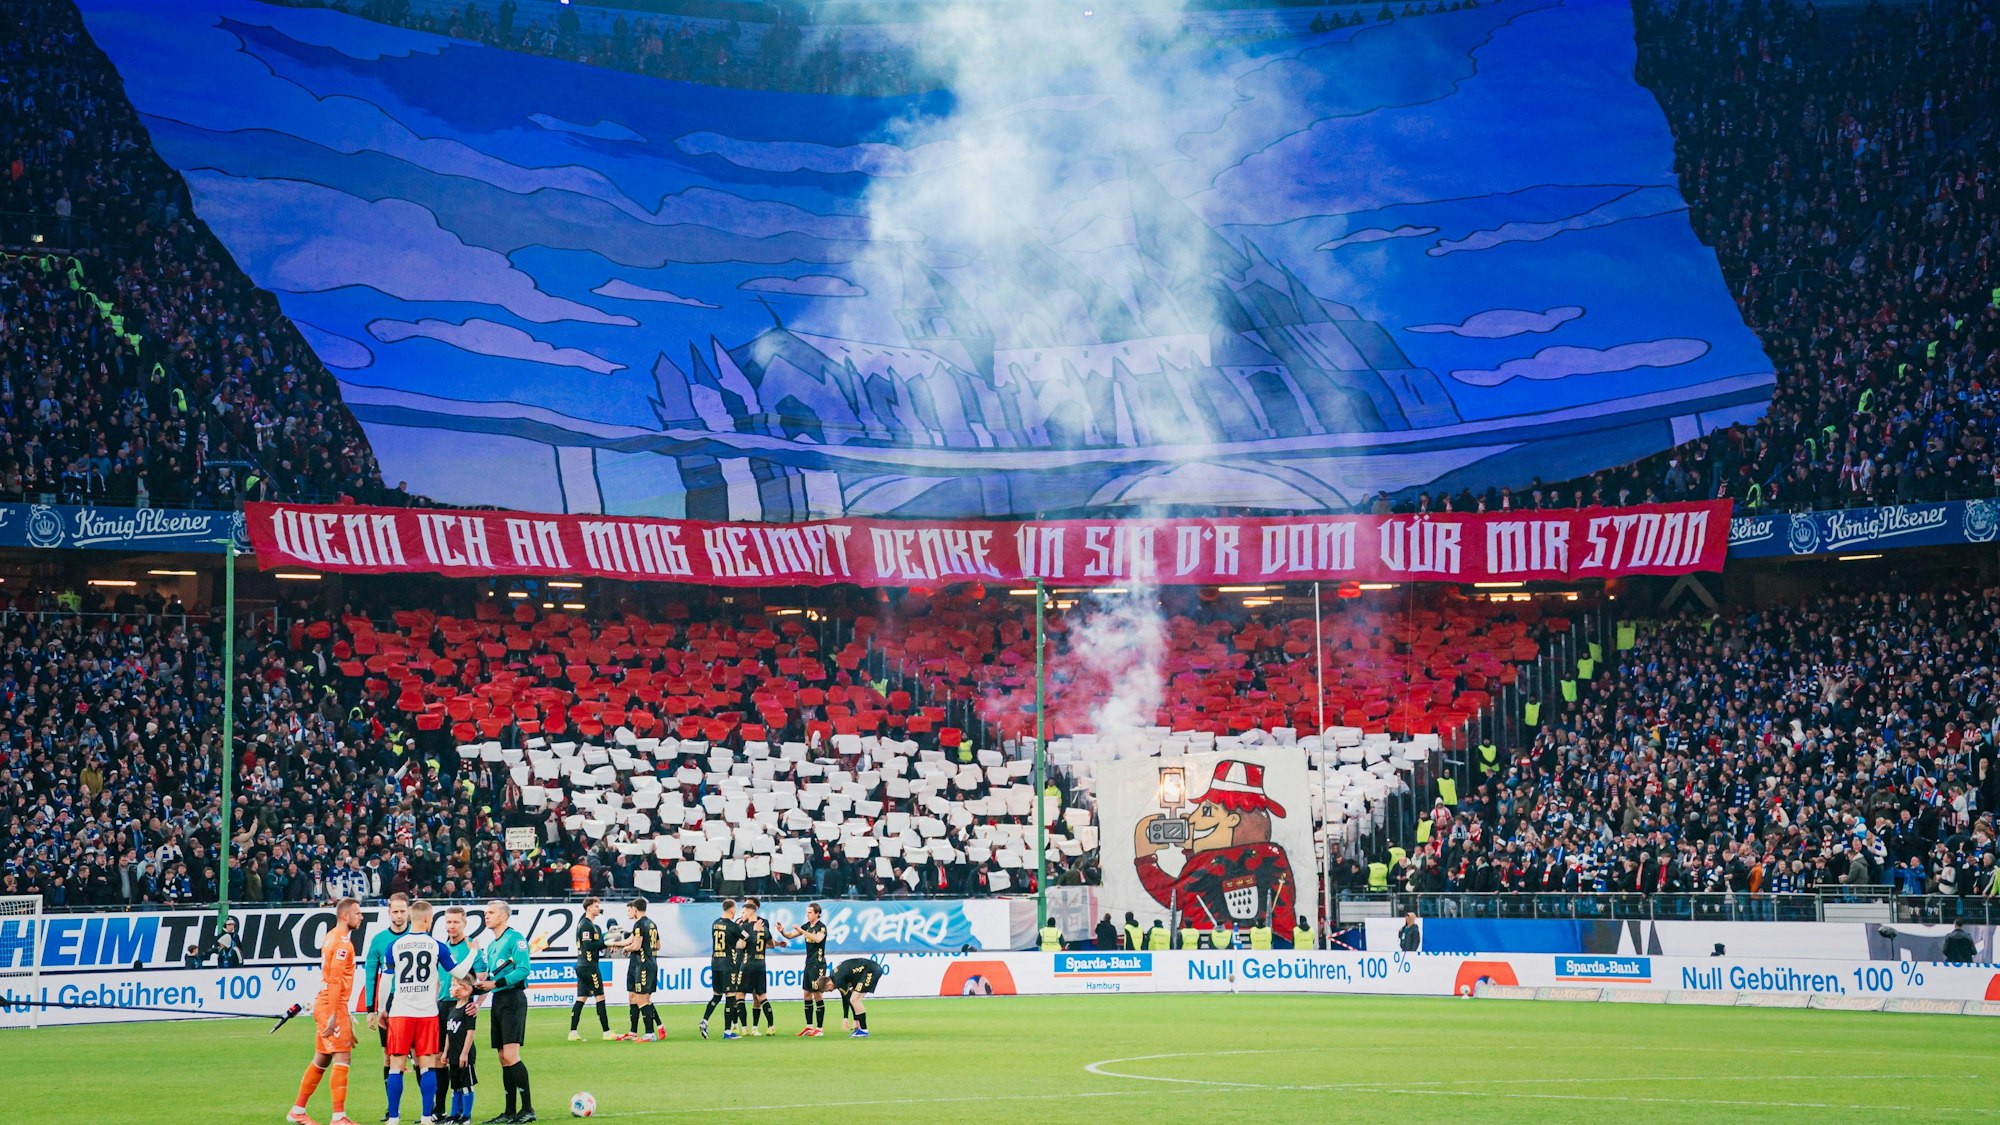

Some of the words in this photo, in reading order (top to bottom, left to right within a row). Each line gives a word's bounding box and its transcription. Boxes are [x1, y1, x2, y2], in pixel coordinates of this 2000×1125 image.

[71, 507, 135, 540] König
[135, 507, 212, 534] Pilsener
[1729, 519, 1774, 540] sener
[1825, 514, 1878, 540] König
[1877, 504, 1946, 533] Pilsener
[270, 508, 408, 567] WENN
[416, 513, 496, 569] ICH
[504, 517, 572, 569] AN
[577, 520, 693, 577] MING
[701, 524, 853, 578] HEIMAT
[869, 527, 1004, 580] DENKE
[1260, 521, 1358, 576] DOM
[1485, 518, 1570, 574] MIR
[1578, 509, 1711, 570] STONN
[396, 941, 427, 950] HAMBURGER
[713, 930, 726, 951] 13
[755, 931, 765, 952] 5
[398, 950, 432, 984] 28
[1065, 956, 1142, 973] Sparda-Bank
[1188, 959, 1234, 980] Null
[1242, 957, 1353, 984] Gebühren,
[1357, 957, 1388, 979] 100
[1393, 951, 1411, 974] %
[1566, 959, 1641, 976] Sparda-Bank
[58, 981, 205, 1010] Gebühren,
[215, 974, 262, 1001] 100
[271, 966, 296, 992] %
[1086, 981, 1121, 992] Hamburg
[1682, 966, 1723, 990] Null
[1729, 965, 1846, 995] Gebühren,
[1852, 967, 1894, 992] 100
[1901, 960, 1924, 987] %
[399, 985, 429, 993] MUHEIM
[533, 993, 575, 1006] Hamburg
